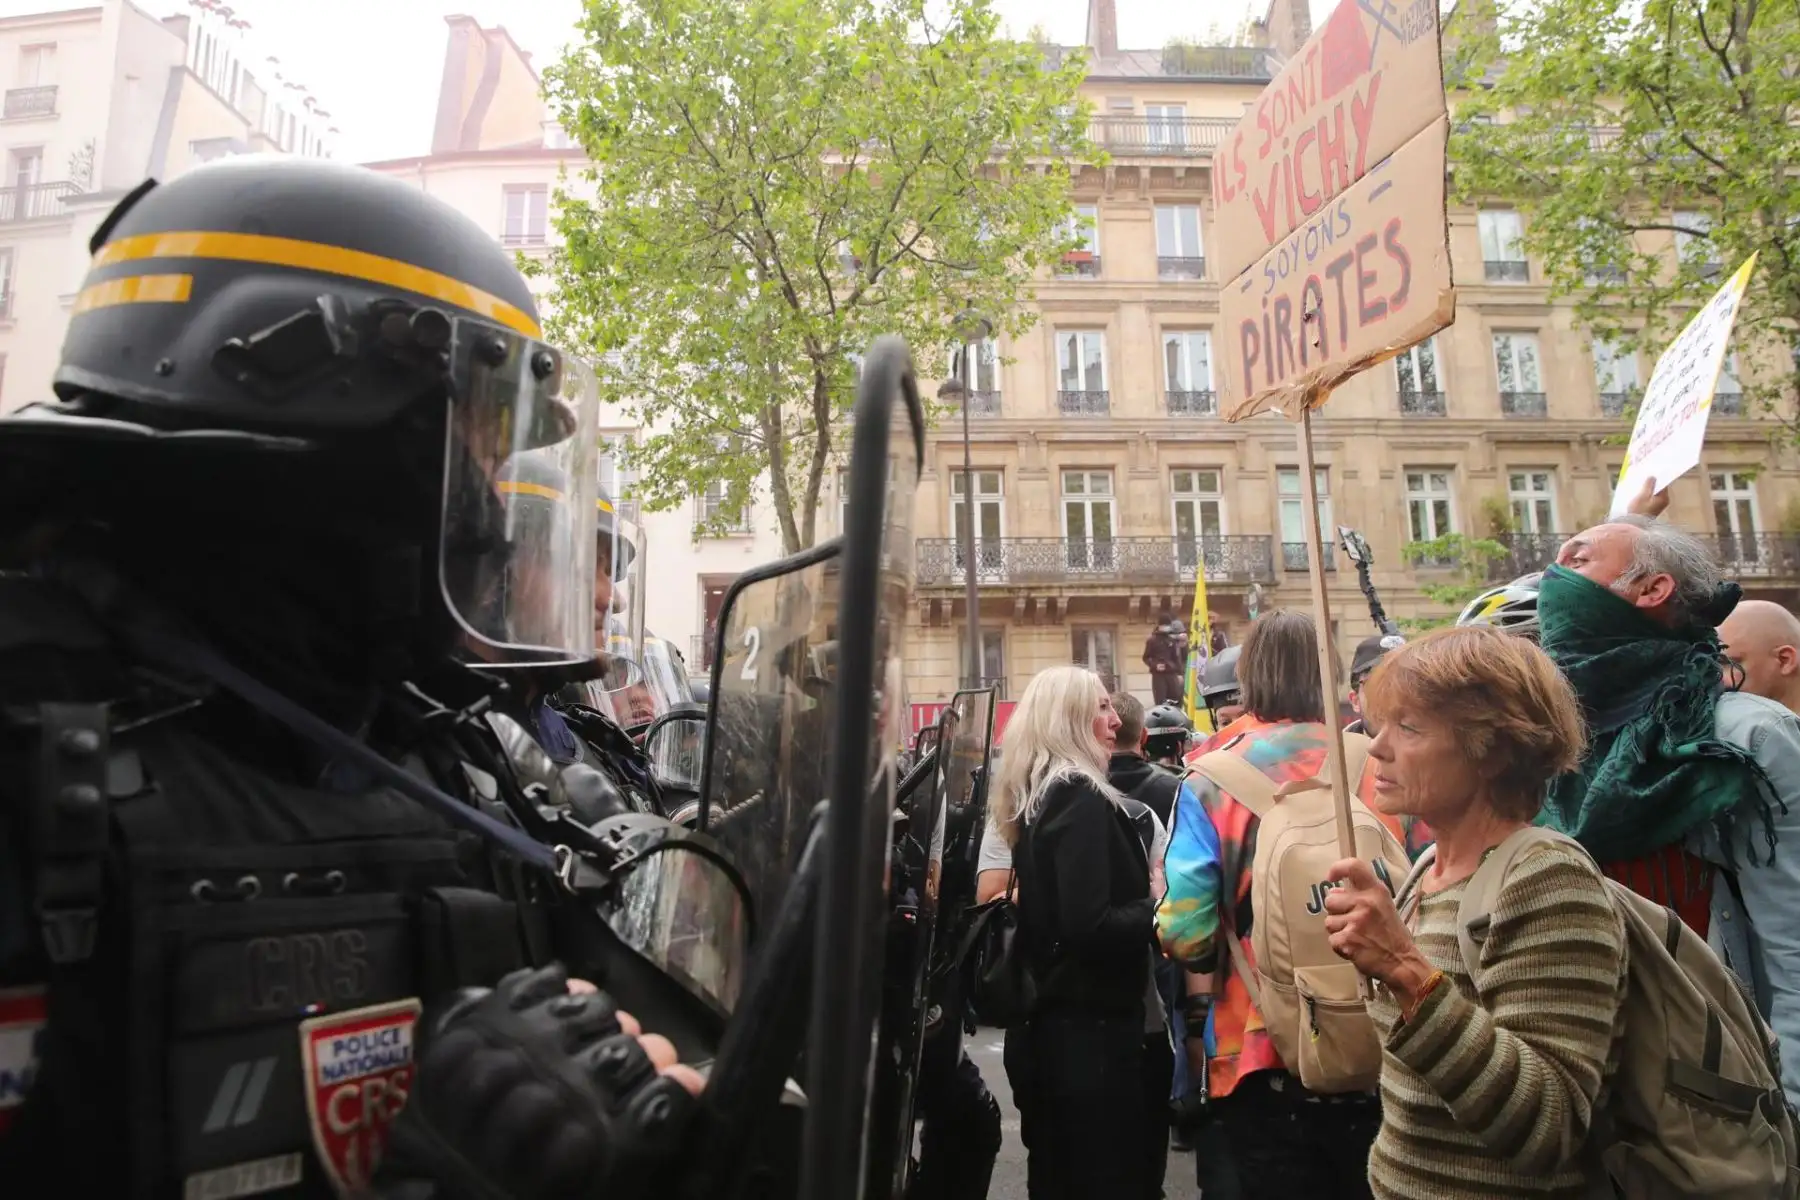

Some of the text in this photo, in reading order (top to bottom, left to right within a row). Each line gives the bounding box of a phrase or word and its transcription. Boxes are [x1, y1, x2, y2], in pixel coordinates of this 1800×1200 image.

[1213, 45, 1319, 209] ILS SONT
[1263, 198, 1352, 295] SOYONS
[740, 626, 760, 680] 2
[245, 929, 369, 1010] CRS
[332, 1027, 401, 1057] POLICE
[326, 1070, 408, 1136] CRS
